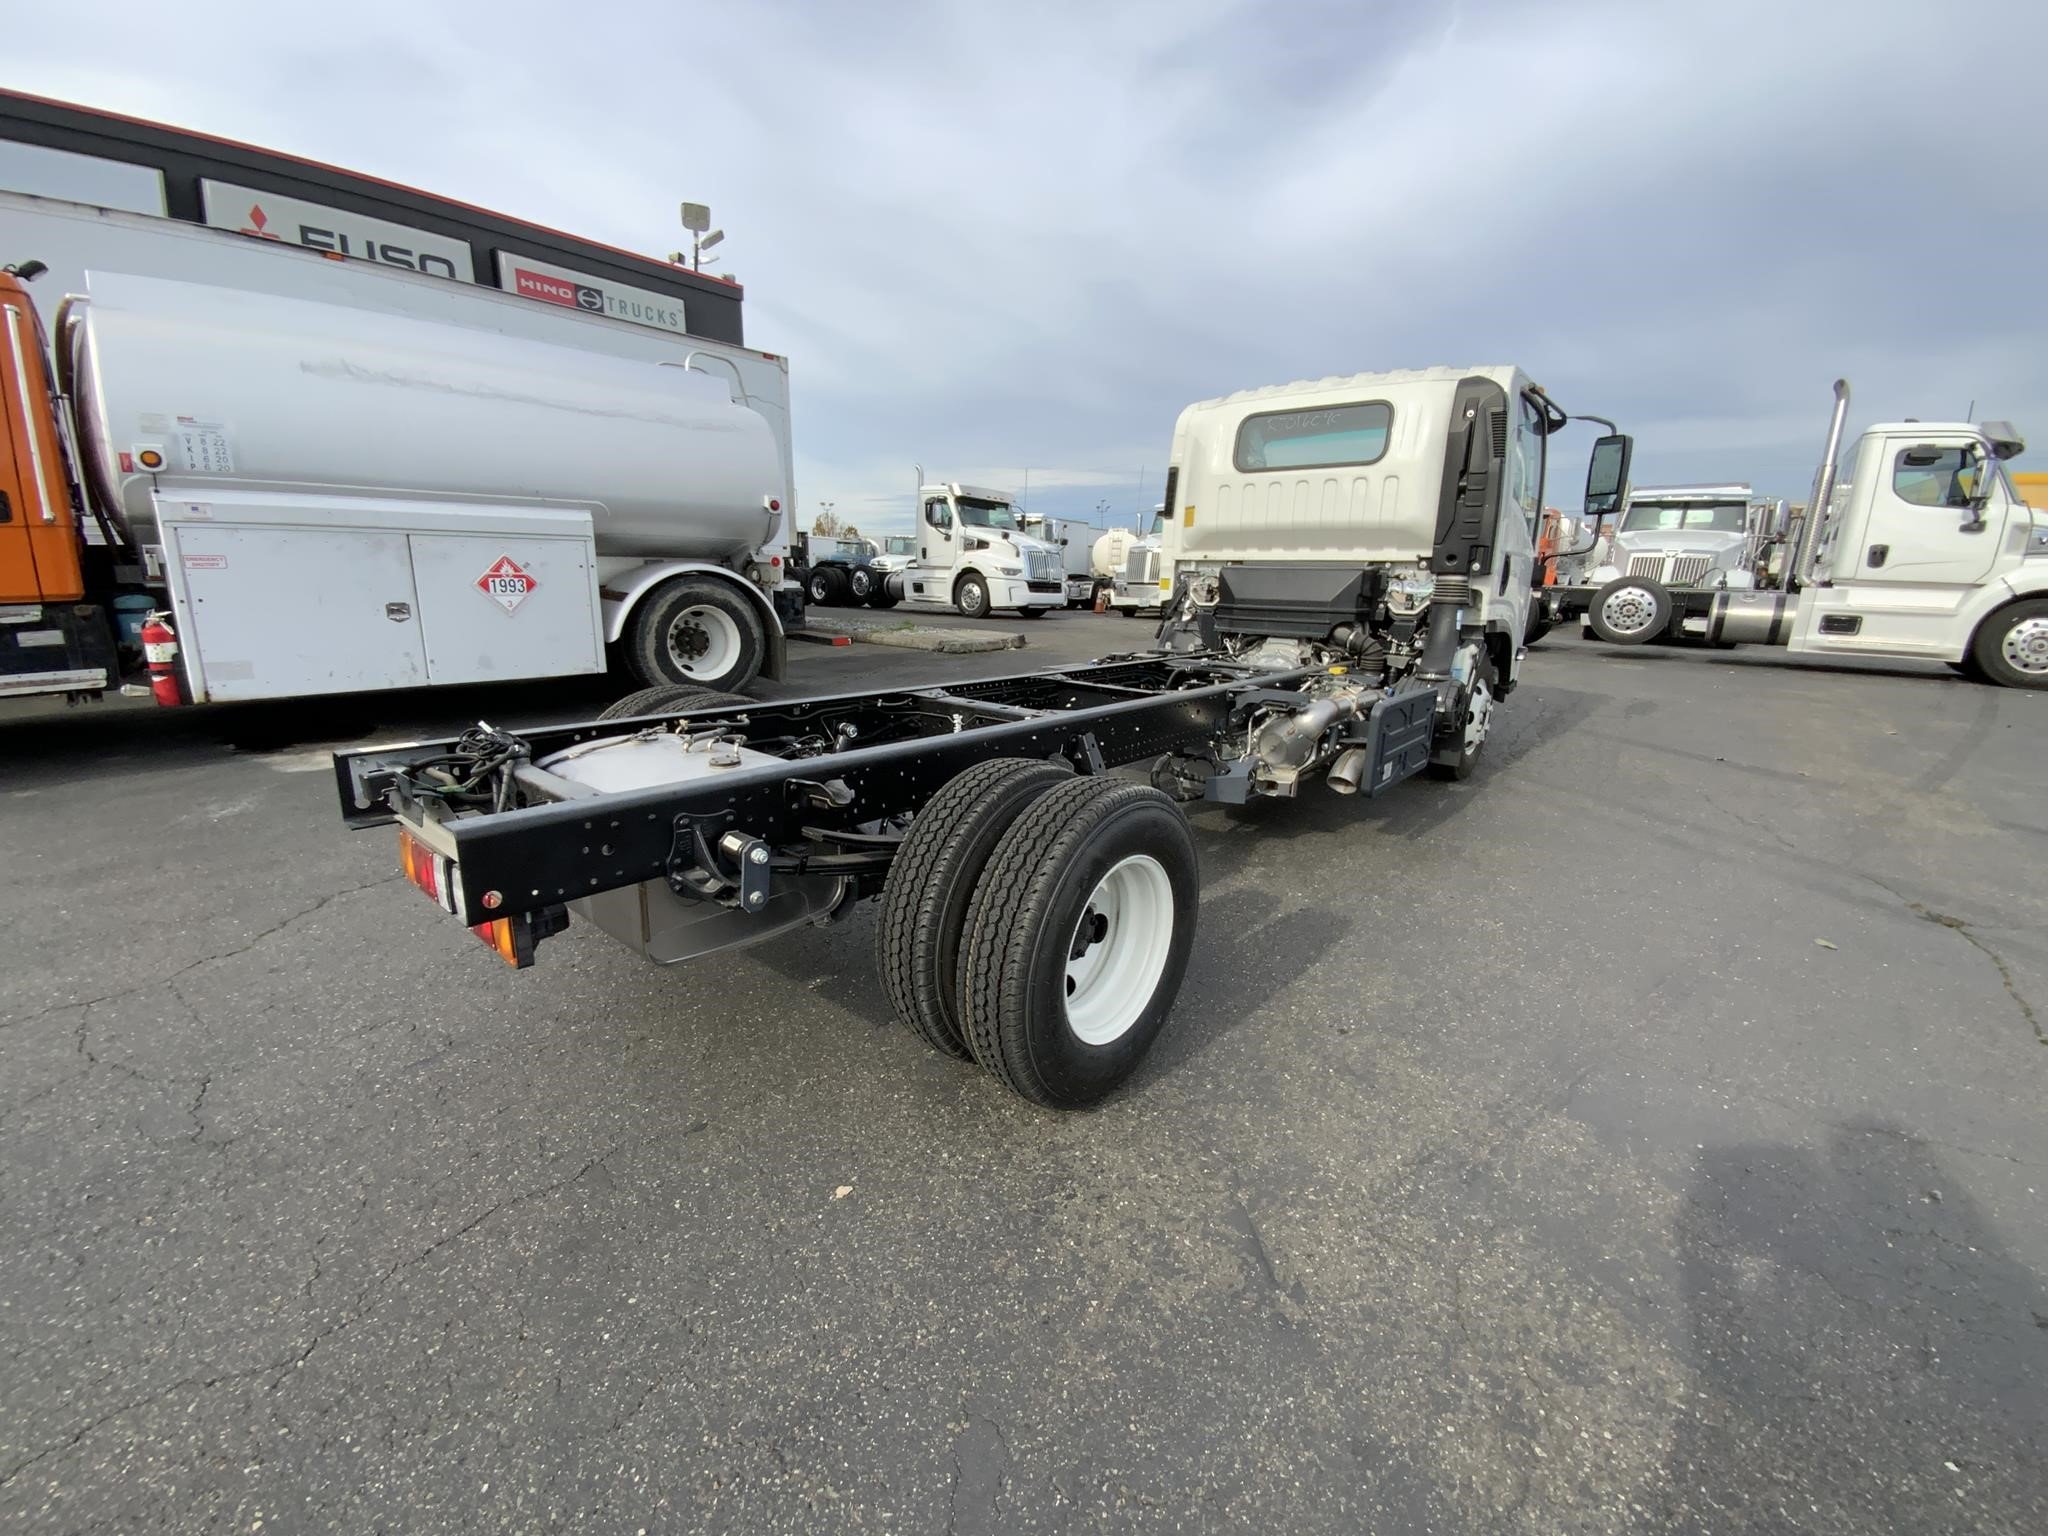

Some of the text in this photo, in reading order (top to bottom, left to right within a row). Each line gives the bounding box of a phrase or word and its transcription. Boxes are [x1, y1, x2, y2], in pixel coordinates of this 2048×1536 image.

[520, 277, 678, 327] HINO TRUCKS
[490, 578, 526, 593] 1993
[507, 600, 514, 608] 3
